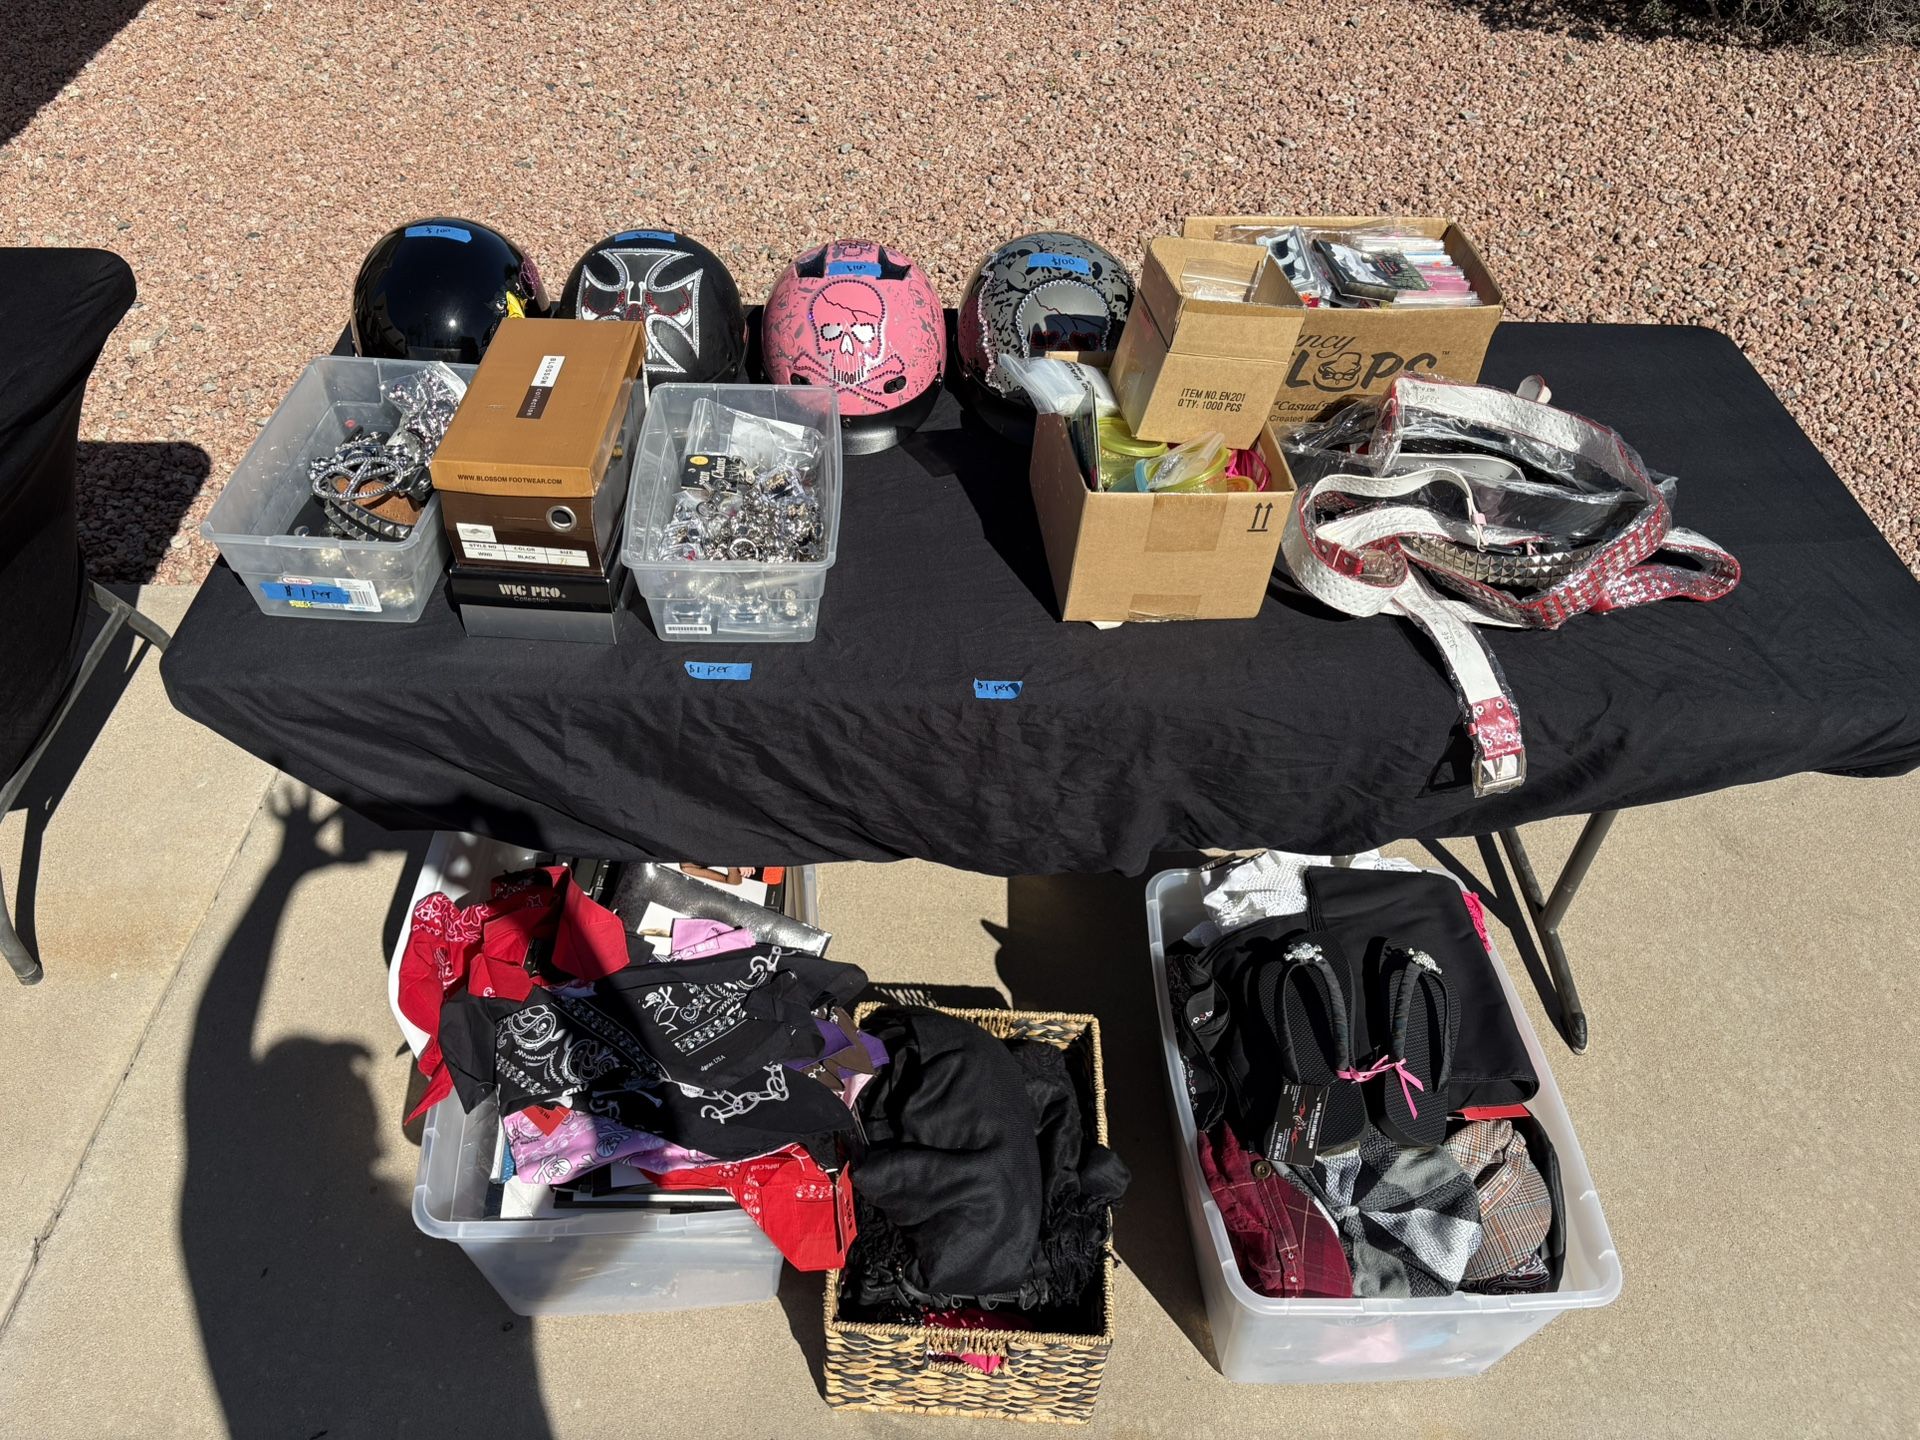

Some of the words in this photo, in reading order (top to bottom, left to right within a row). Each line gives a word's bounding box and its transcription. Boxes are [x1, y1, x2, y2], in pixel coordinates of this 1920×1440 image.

[1051, 256, 1076, 266] $100
[1296, 334, 1357, 359] ncy
[540, 357, 557, 385] BLOSSOM
[1181, 388, 1204, 399] ITEM
[1202, 401, 1224, 411] 1000
[1224, 402, 1243, 412] PCS
[1269, 415, 1303, 423] Created
[311, 589, 332, 600] per
[498, 584, 527, 596] WIG
[513, 595, 550, 603] Collection
[688, 664, 700, 674] $1
[707, 664, 730, 676] per
[993, 683, 1012, 695] per
